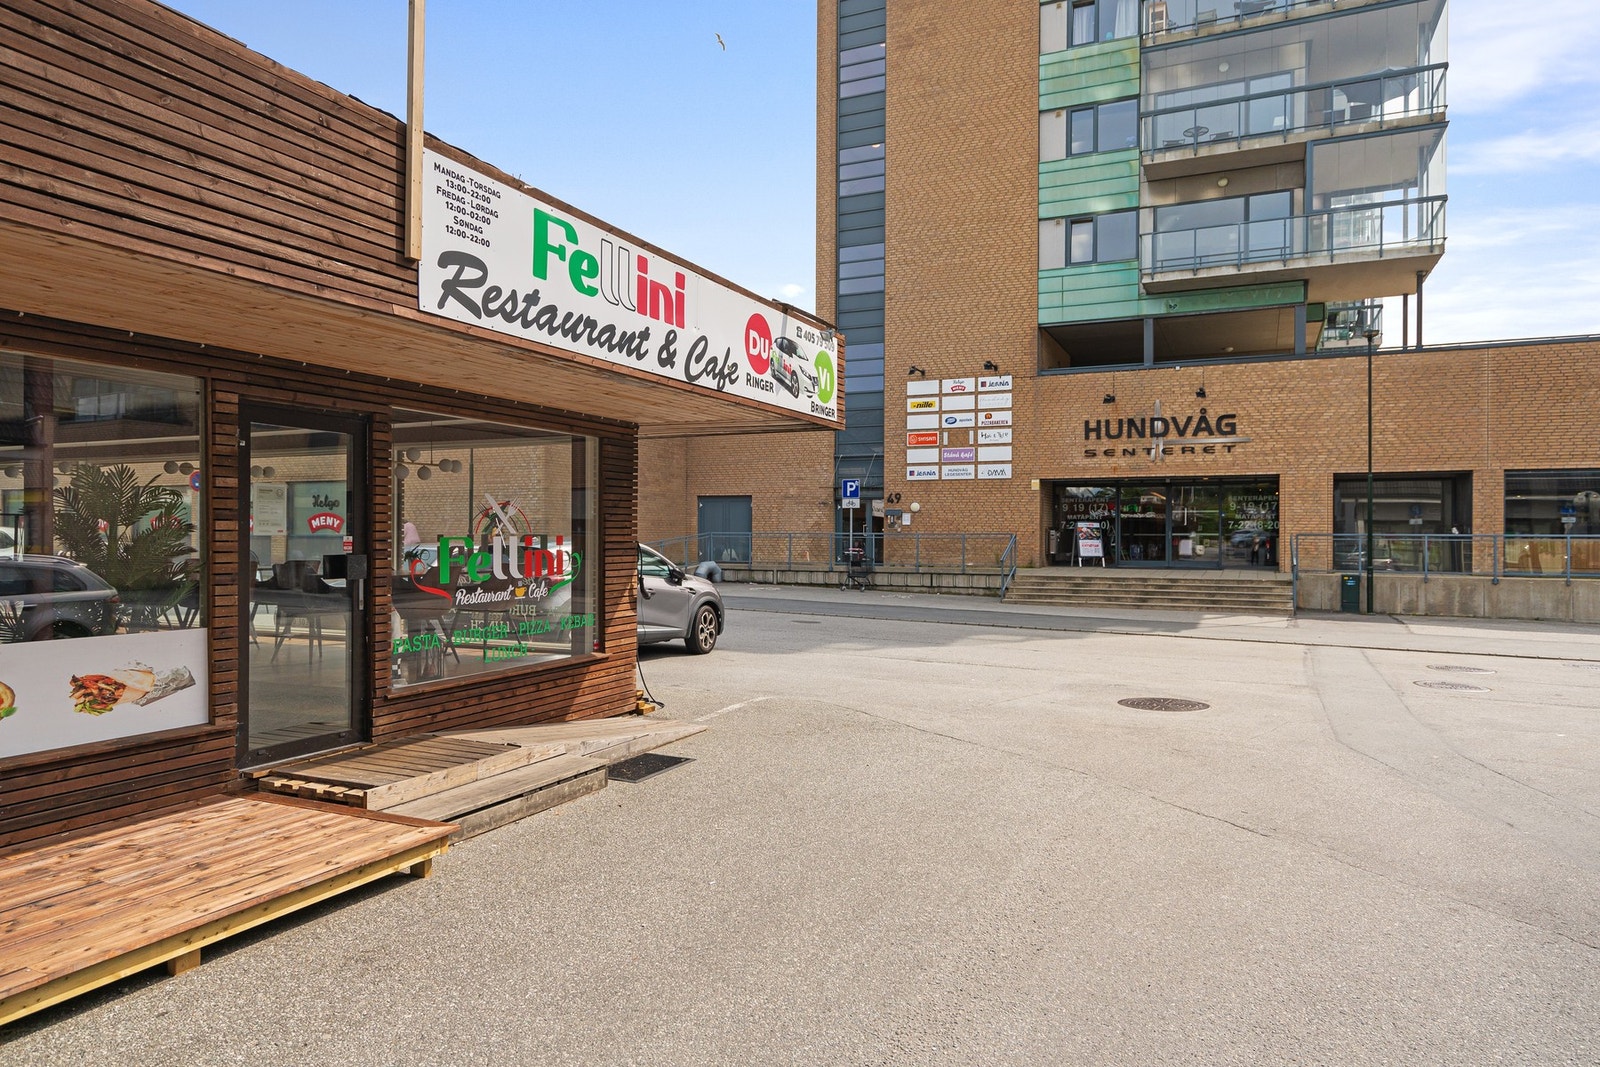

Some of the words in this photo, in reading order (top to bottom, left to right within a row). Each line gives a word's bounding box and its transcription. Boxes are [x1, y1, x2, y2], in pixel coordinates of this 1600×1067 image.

[445, 179, 491, 205] 13:00-22:00
[445, 201, 491, 225] 12:00-02:00
[445, 225, 491, 248] 12:00-22:00
[453, 216, 484, 235] SØNDAG
[533, 207, 686, 329] Fellini
[437, 250, 651, 361] Restaurant
[658, 329, 678, 369] &
[684, 334, 739, 391] Cafe
[749, 329, 769, 359] DU
[803, 329, 816, 344] 405
[746, 372, 774, 394] RINGER
[818, 366, 830, 392] VI
[810, 401, 836, 419] BRINGER
[1085, 408, 1237, 440] HUNDVÅG
[1085, 445, 1237, 458] SENTERET
[846, 482, 855, 496] P
[887, 493, 901, 504] 49
[311, 516, 340, 529] MENY
[439, 535, 564, 584] Fellini
[455, 584, 515, 605] Restaurant
[528, 580, 548, 601] Cafe
[392, 633, 441, 654] PASTA
[453, 624, 509, 646] BURGER
[519, 619, 551, 637] PIZZA
[560, 613, 595, 631] KEBAB
[484, 643, 528, 664] LUNCH
